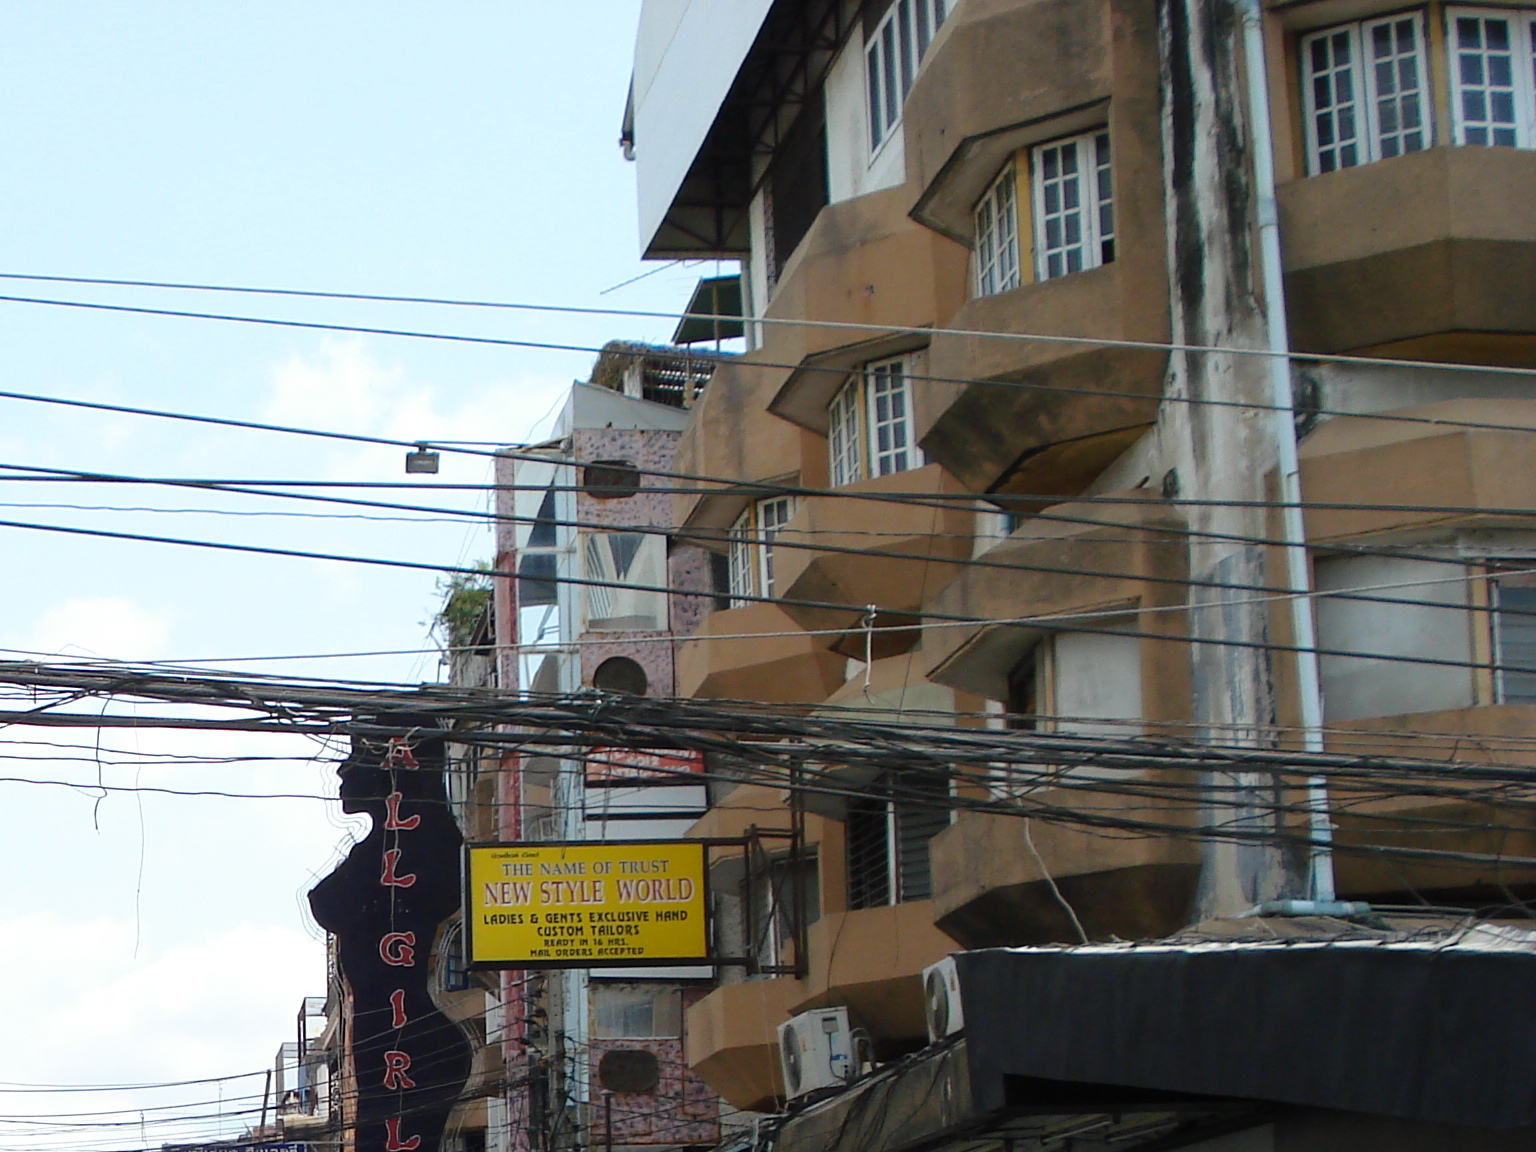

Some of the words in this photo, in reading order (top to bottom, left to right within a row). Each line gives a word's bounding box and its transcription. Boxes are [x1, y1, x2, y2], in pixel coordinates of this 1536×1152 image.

[503, 863, 533, 877] THE
[539, 861, 586, 876] NAME
[593, 860, 613, 874] OF
[619, 859, 669, 873] TRUST
[484, 880, 533, 907] NEW
[539, 879, 606, 906] STYLE
[616, 876, 697, 904] WORLD
[484, 913, 524, 925] LADIES
[530, 912, 539, 924] &
[545, 911, 583, 924] GENTS
[589, 909, 650, 923] EXCLUSIVE
[655, 909, 689, 922] HAND
[537, 925, 584, 937] CUSTOM
[590, 924, 640, 936] TAILORS
[544, 938, 575, 948] READY
[579, 938, 589, 947] IN
[608, 937, 630, 947] HRS.
[530, 949, 551, 958] MAIL
[556, 948, 593, 957] ORDERS
[597, 946, 645, 956] ACCEPTED
